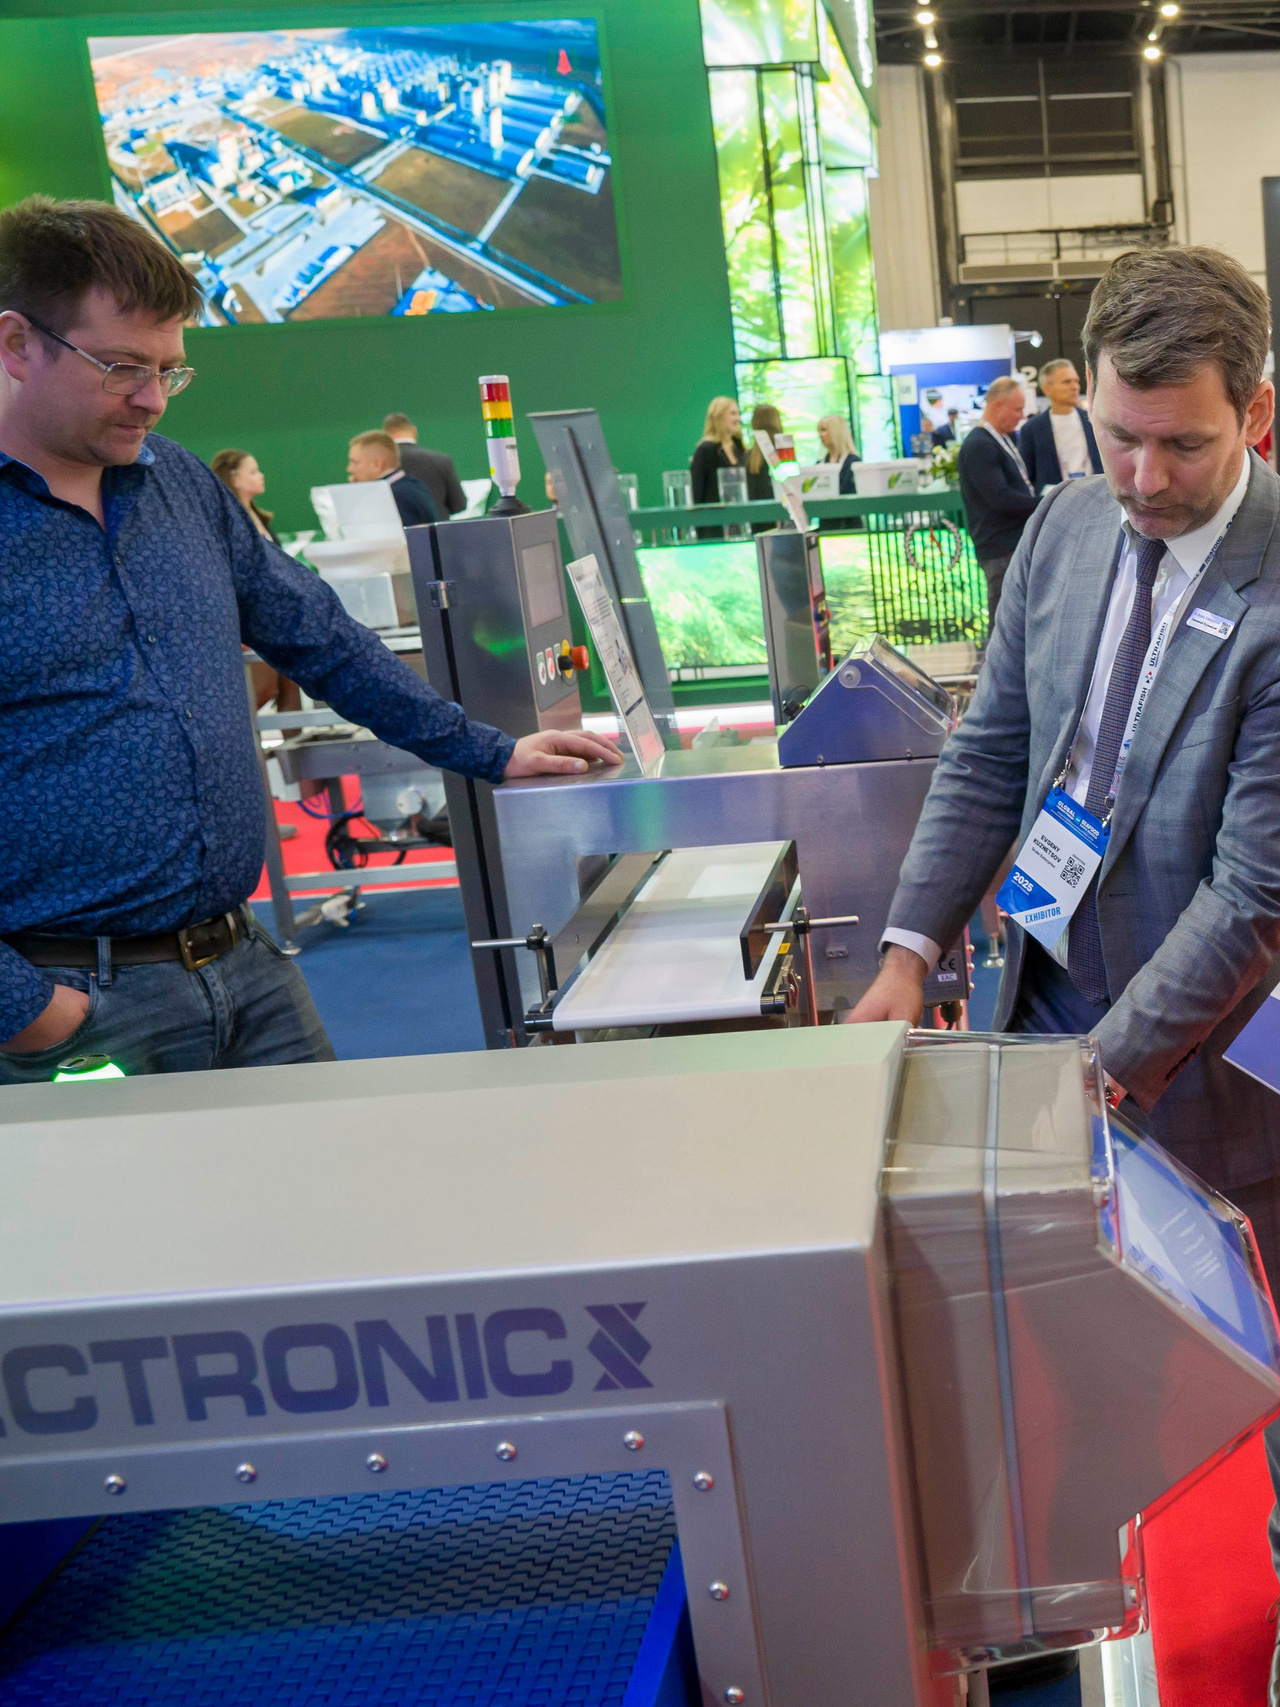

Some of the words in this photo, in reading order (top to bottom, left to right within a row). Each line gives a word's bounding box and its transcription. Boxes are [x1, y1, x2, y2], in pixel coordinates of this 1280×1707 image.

[1149, 622, 1168, 667] ULTRAFISH
[1033, 838, 1062, 863] KUZNETSOV
[1040, 834, 1061, 852] EVGENY
[1012, 871, 1034, 892] 2025
[1025, 906, 1061, 924] EXHIBITOR
[0, 1307, 574, 1438] CTRONIC
